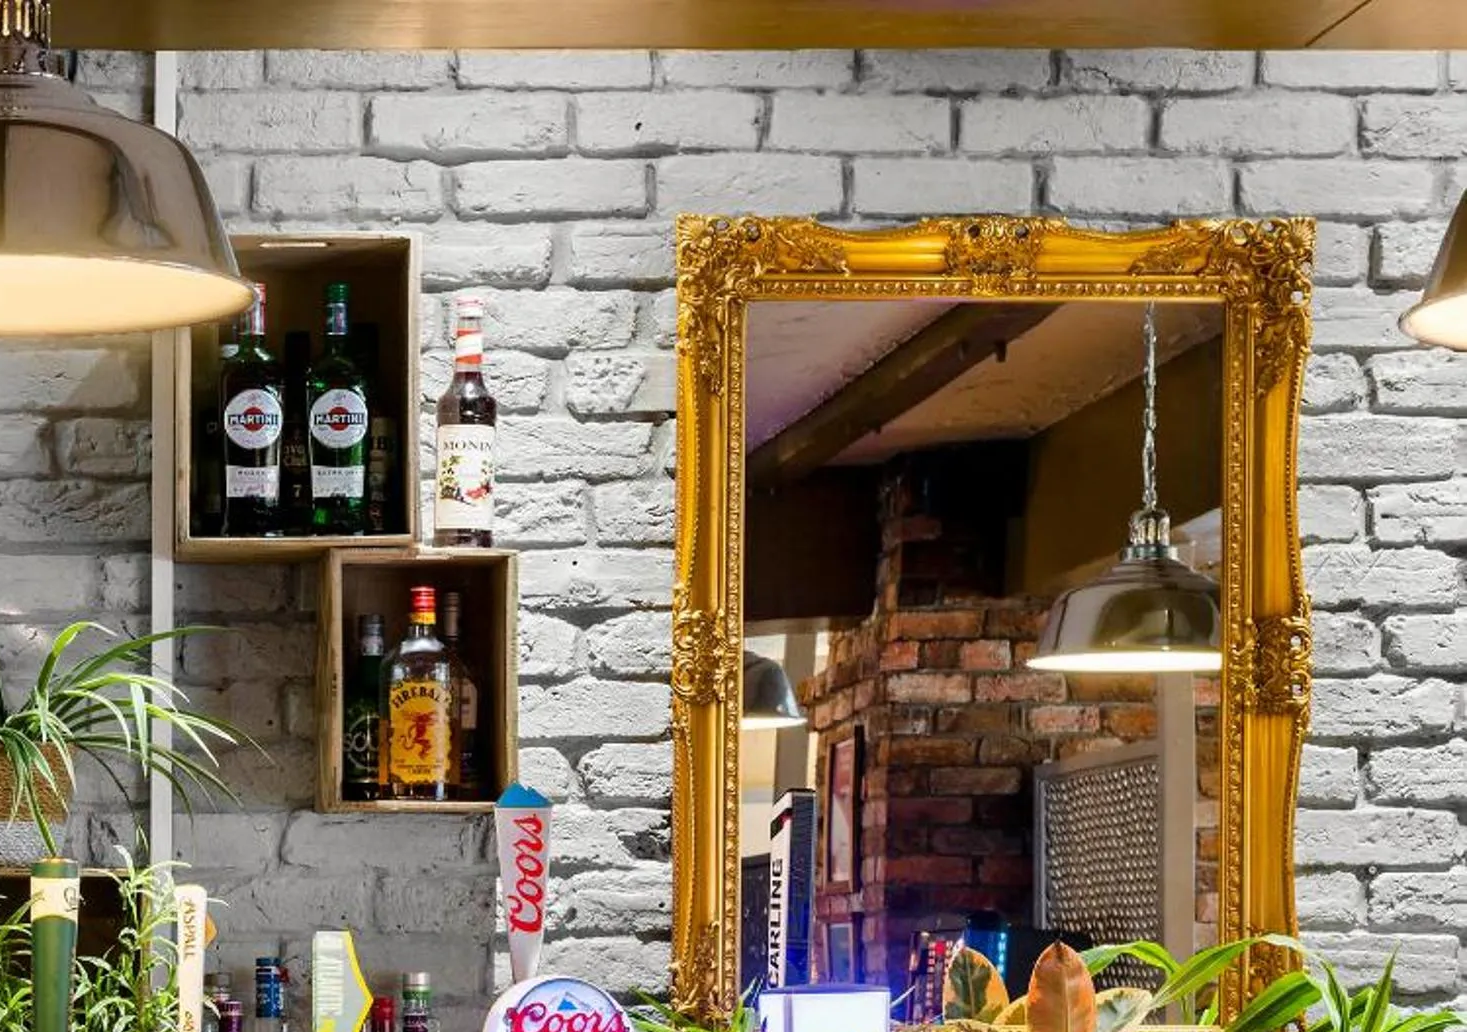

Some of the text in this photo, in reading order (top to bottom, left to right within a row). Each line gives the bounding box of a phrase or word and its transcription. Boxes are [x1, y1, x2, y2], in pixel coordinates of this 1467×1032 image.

[228, 414, 278, 425] MARTINI
[315, 413, 364, 424] MARTINI
[508, 814, 544, 933] Coors
[184, 900, 196, 960] ASPALL
[768, 858, 783, 989] CARLING
